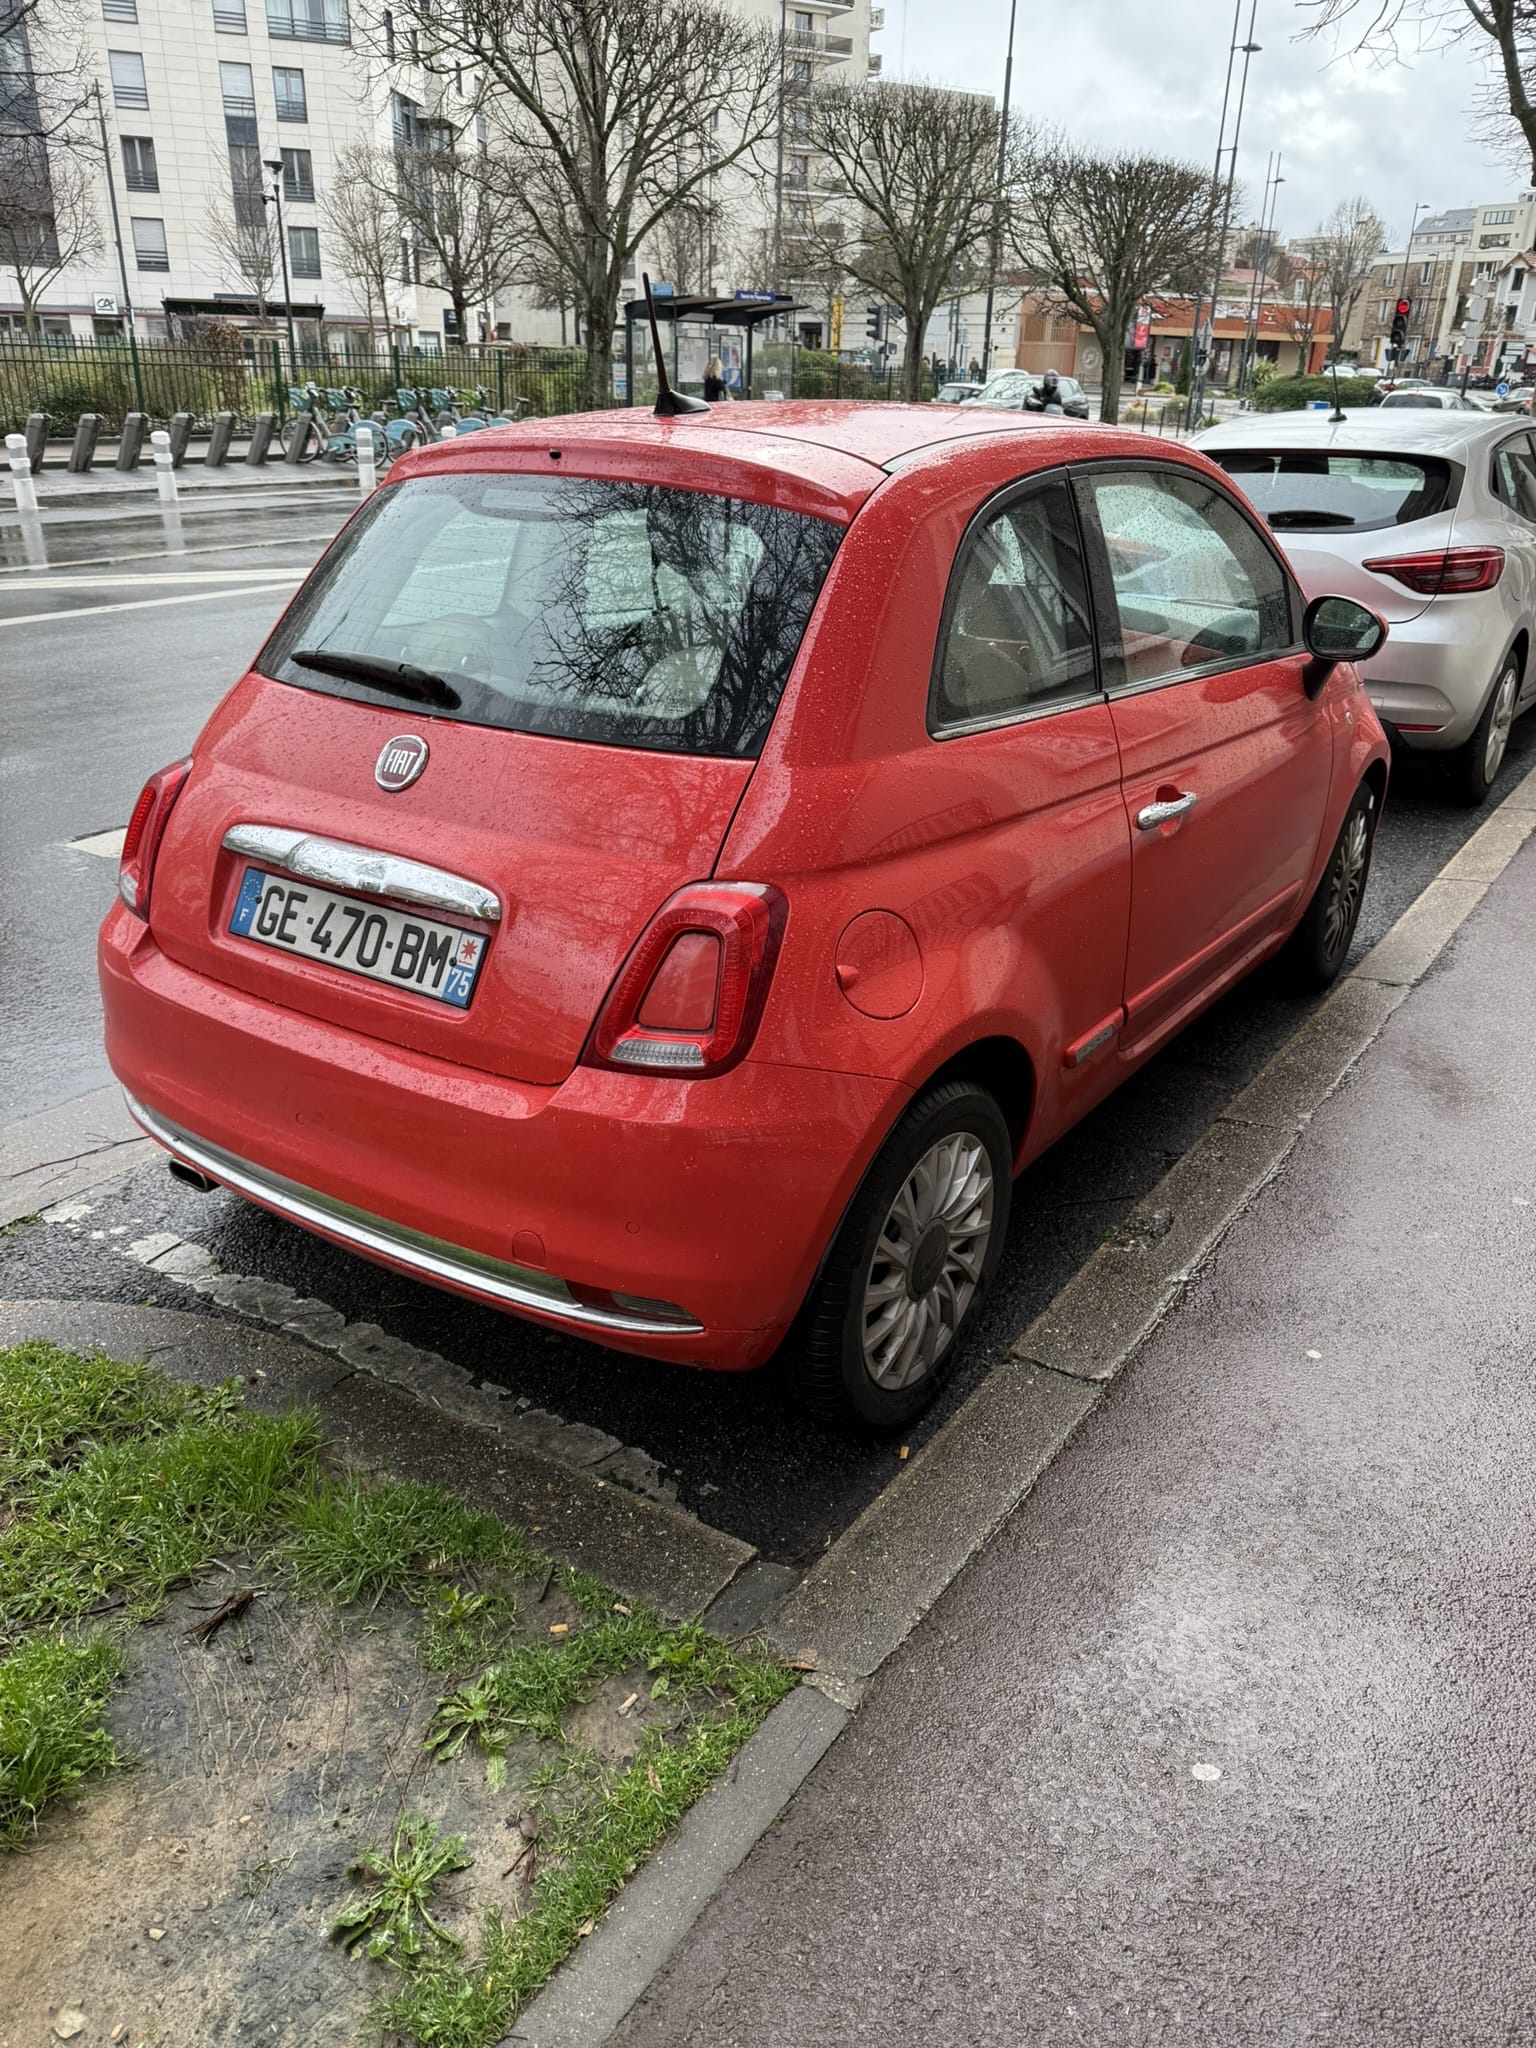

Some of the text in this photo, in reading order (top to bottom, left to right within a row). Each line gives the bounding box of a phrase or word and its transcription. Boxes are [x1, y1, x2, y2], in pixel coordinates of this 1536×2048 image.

[384, 749, 418, 775] FIAT
[238, 907, 249, 922] F
[256, 885, 453, 988] GE-470-BM
[447, 969, 473, 997] 75
